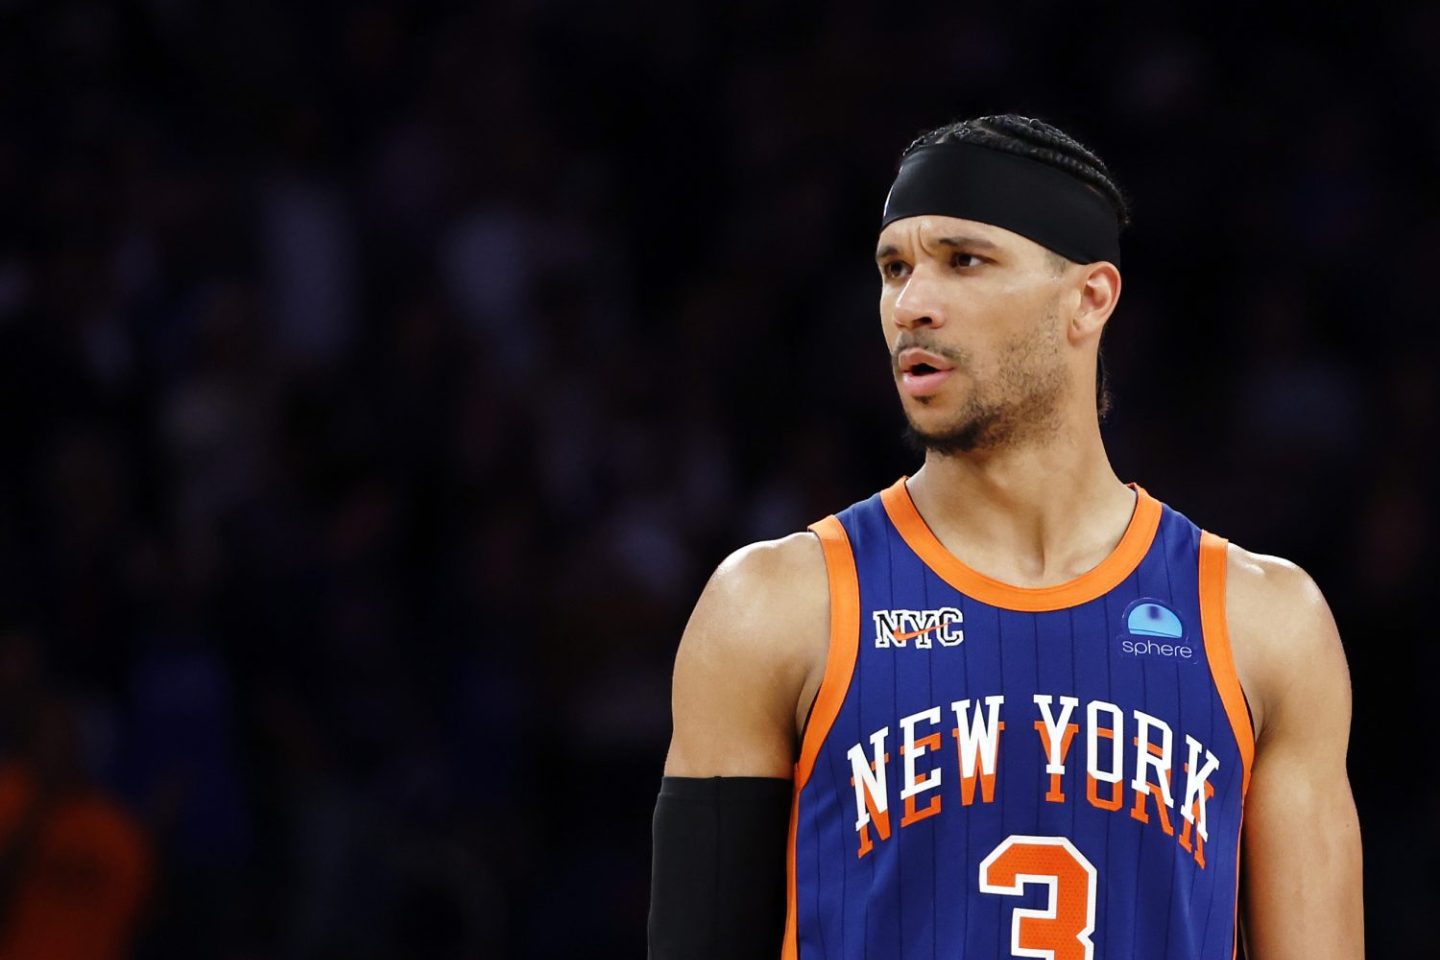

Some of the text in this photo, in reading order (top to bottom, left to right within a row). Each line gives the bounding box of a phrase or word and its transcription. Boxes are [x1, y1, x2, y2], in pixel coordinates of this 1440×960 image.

[873, 607, 964, 649] NYC
[1122, 639, 1193, 659] sphere
[847, 694, 1220, 869] NEW YORK
